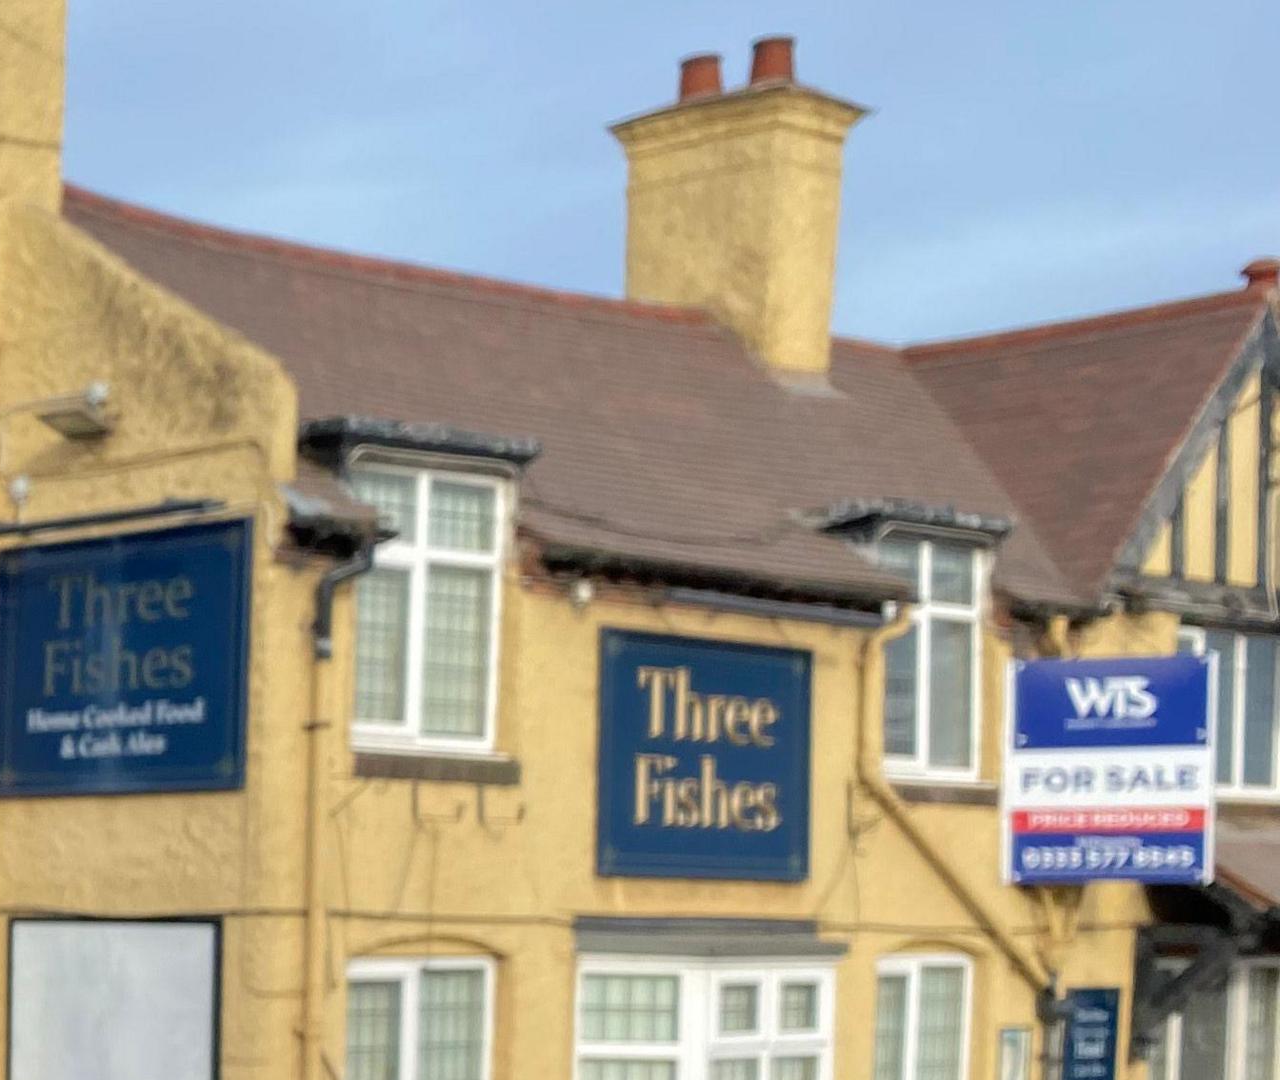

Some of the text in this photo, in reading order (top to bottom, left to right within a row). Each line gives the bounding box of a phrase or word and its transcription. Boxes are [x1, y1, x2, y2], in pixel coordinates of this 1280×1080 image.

[50, 572, 194, 628] Three
[43, 634, 194, 697] Fishes
[27, 697, 206, 732] Home Cooked Food
[637, 665, 779, 747] Three
[1065, 675, 1158, 719] WTS
[634, 753, 783, 831] Fishes
[1020, 764, 1199, 793] FOR SALE
